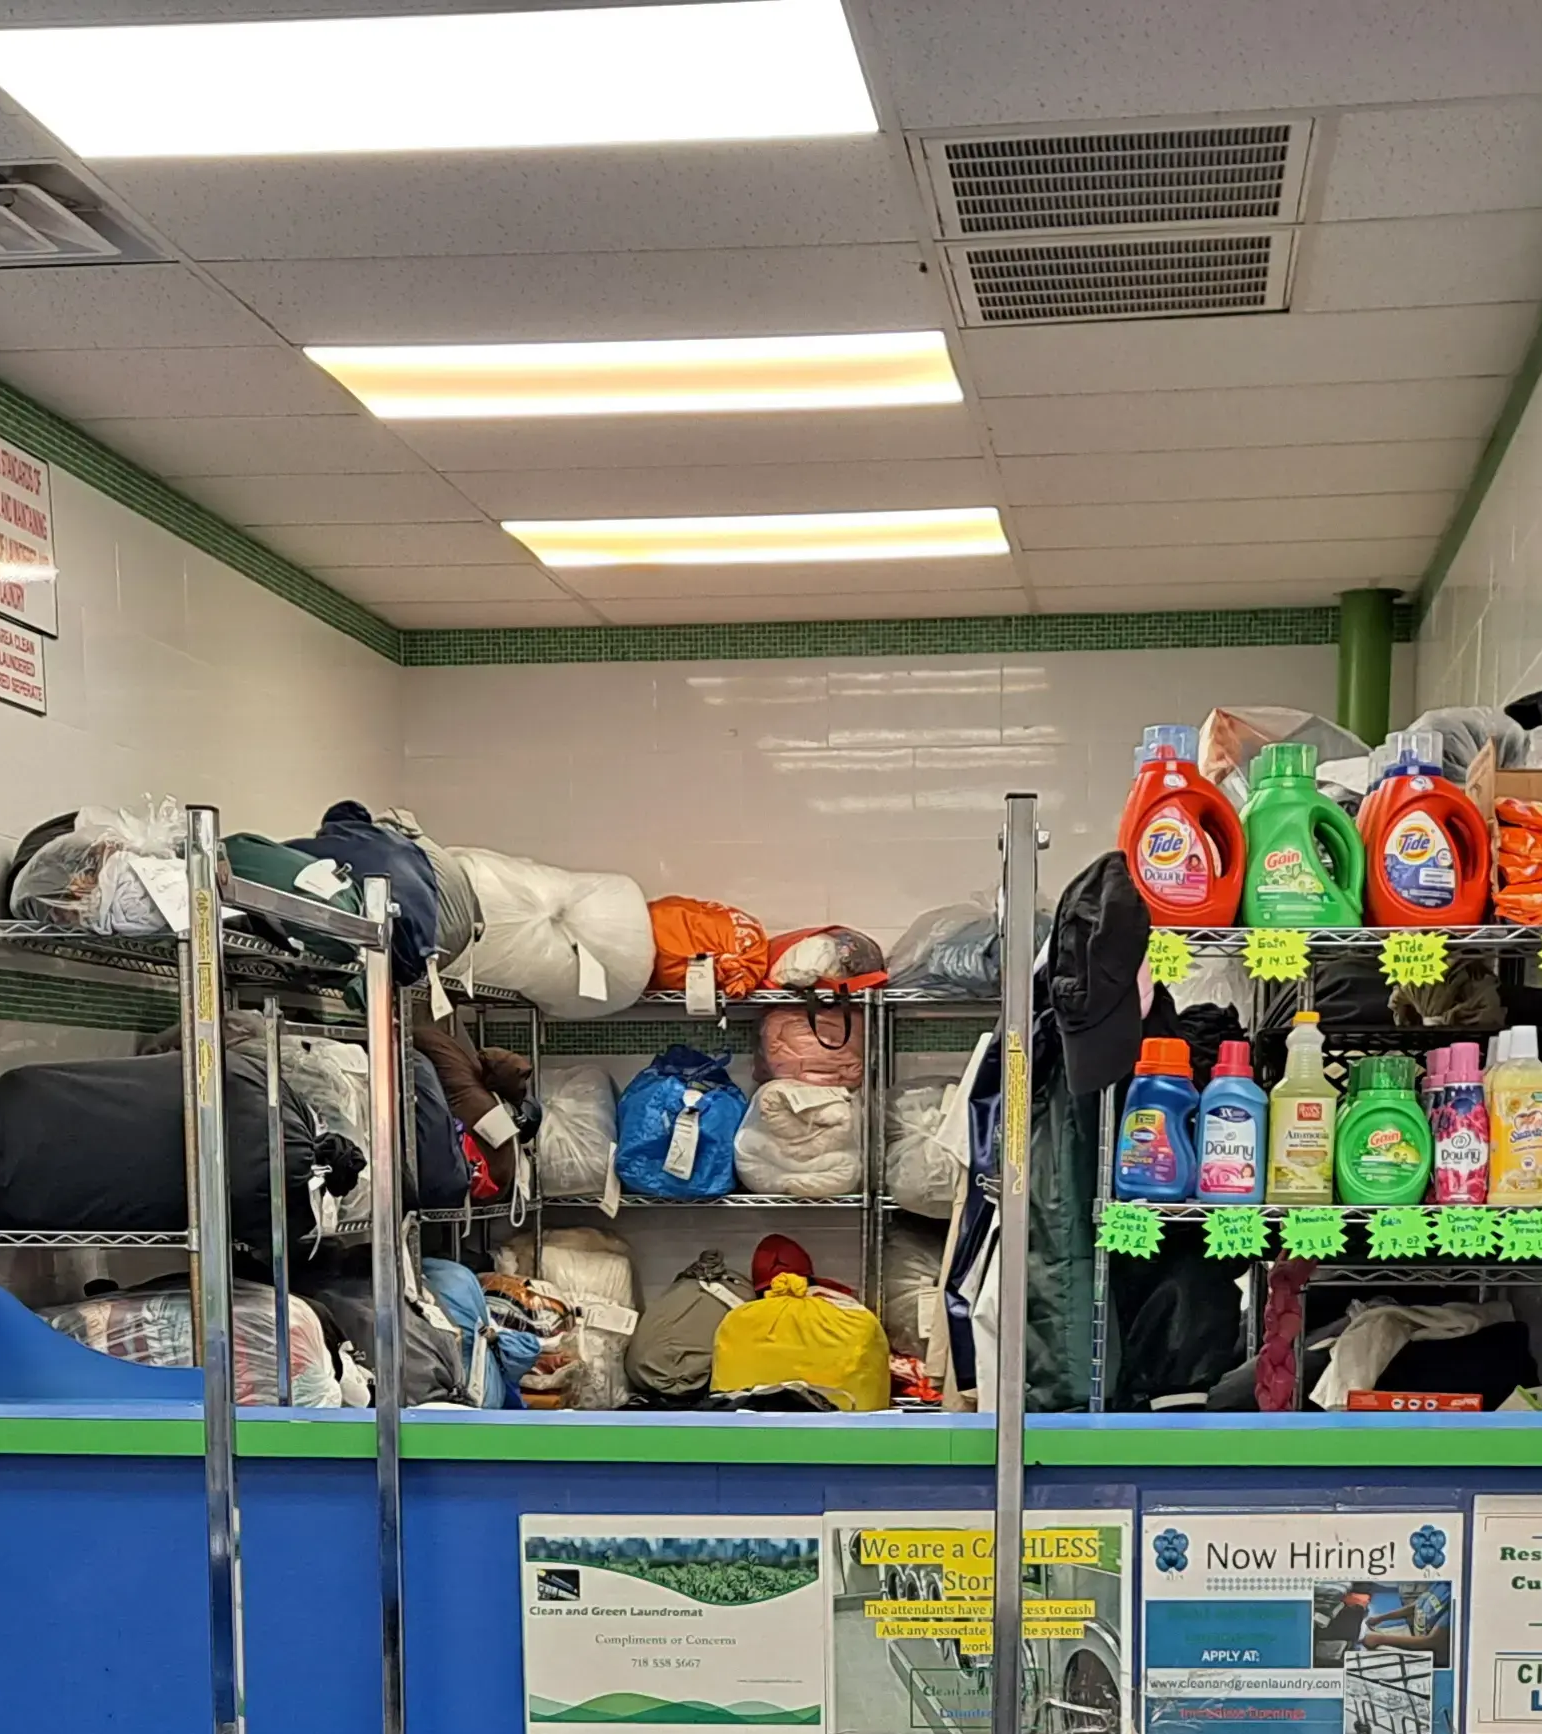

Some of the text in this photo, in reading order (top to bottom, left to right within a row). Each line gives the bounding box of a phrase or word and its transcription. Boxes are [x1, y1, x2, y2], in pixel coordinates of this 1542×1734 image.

[1148, 832, 1183, 854] Tide
[1399, 832, 1430, 853] Tide
[1266, 851, 1301, 869] Gain
[1144, 868, 1185, 884] Downy
[1370, 1131, 1401, 1146] Gain
[1205, 1141, 1254, 1161] Downy
[1441, 1149, 1481, 1163] Downy
[862, 1538, 1097, 1558] We are a CHLESS
[1207, 1541, 1395, 1574] Now Hiring!
[943, 1572, 995, 1591] Stor
[528, 1607, 703, 1616] Clean and Green Laundromat
[866, 1604, 1092, 1615] The attendants have to cash
[594, 1634, 736, 1646] Compliments or Concerns
[882, 1626, 1083, 1639] Ask any associate system
[630, 1658, 649, 1668] 718
[1202, 1650, 1260, 1662] APPLY AT:
